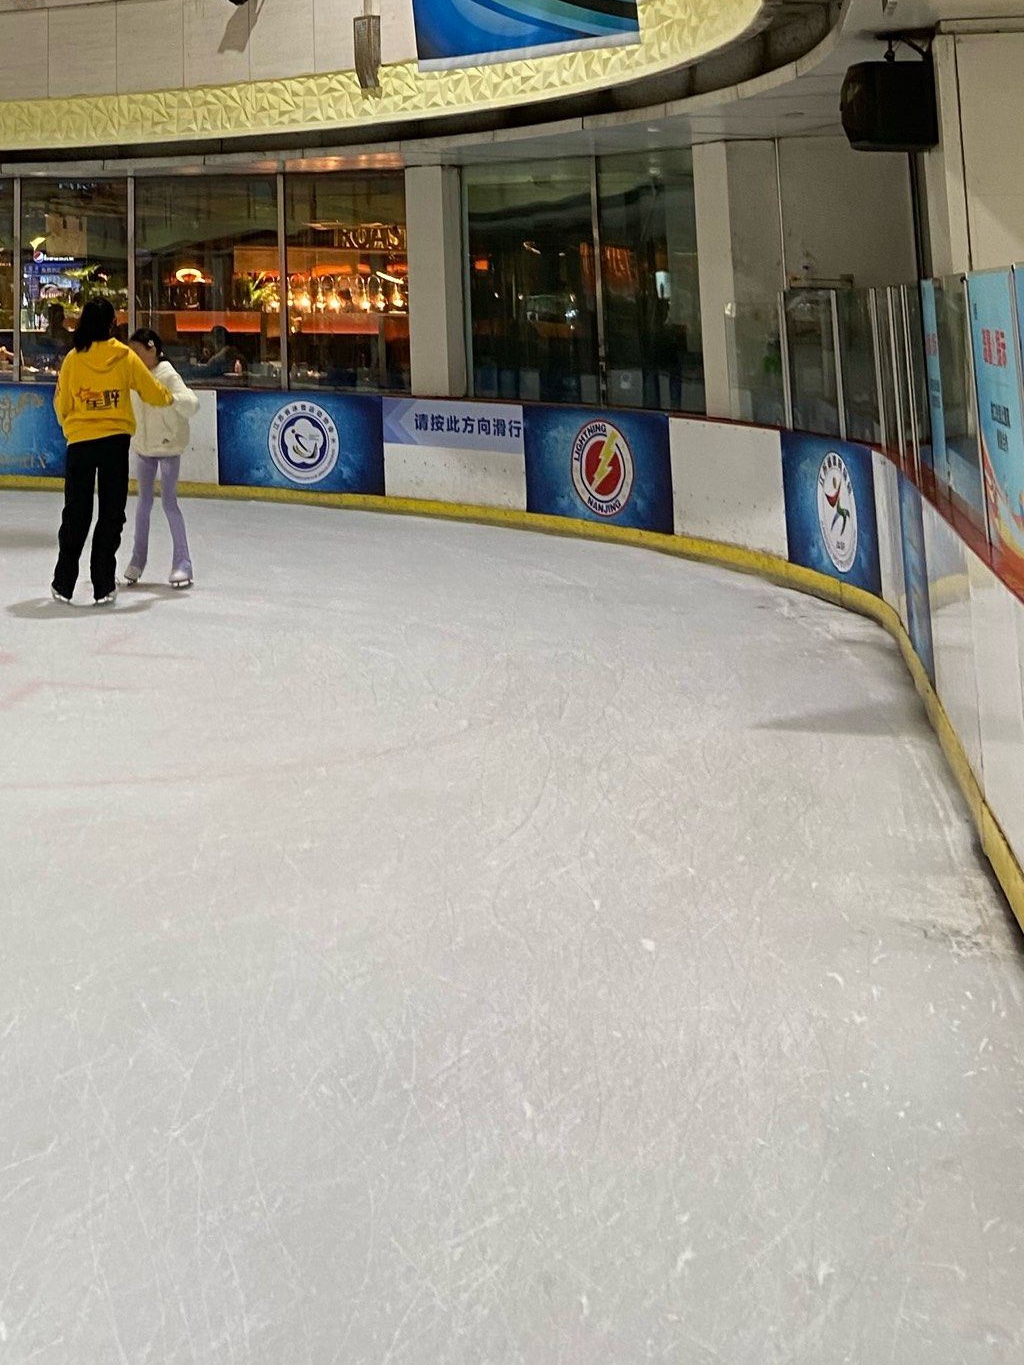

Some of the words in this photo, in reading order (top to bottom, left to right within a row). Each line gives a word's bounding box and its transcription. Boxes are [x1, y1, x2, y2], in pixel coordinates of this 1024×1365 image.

[414, 412, 524, 439] 请按此方向滑行
[573, 422, 608, 463] LIGHTNING
[587, 495, 622, 515] NANJING
